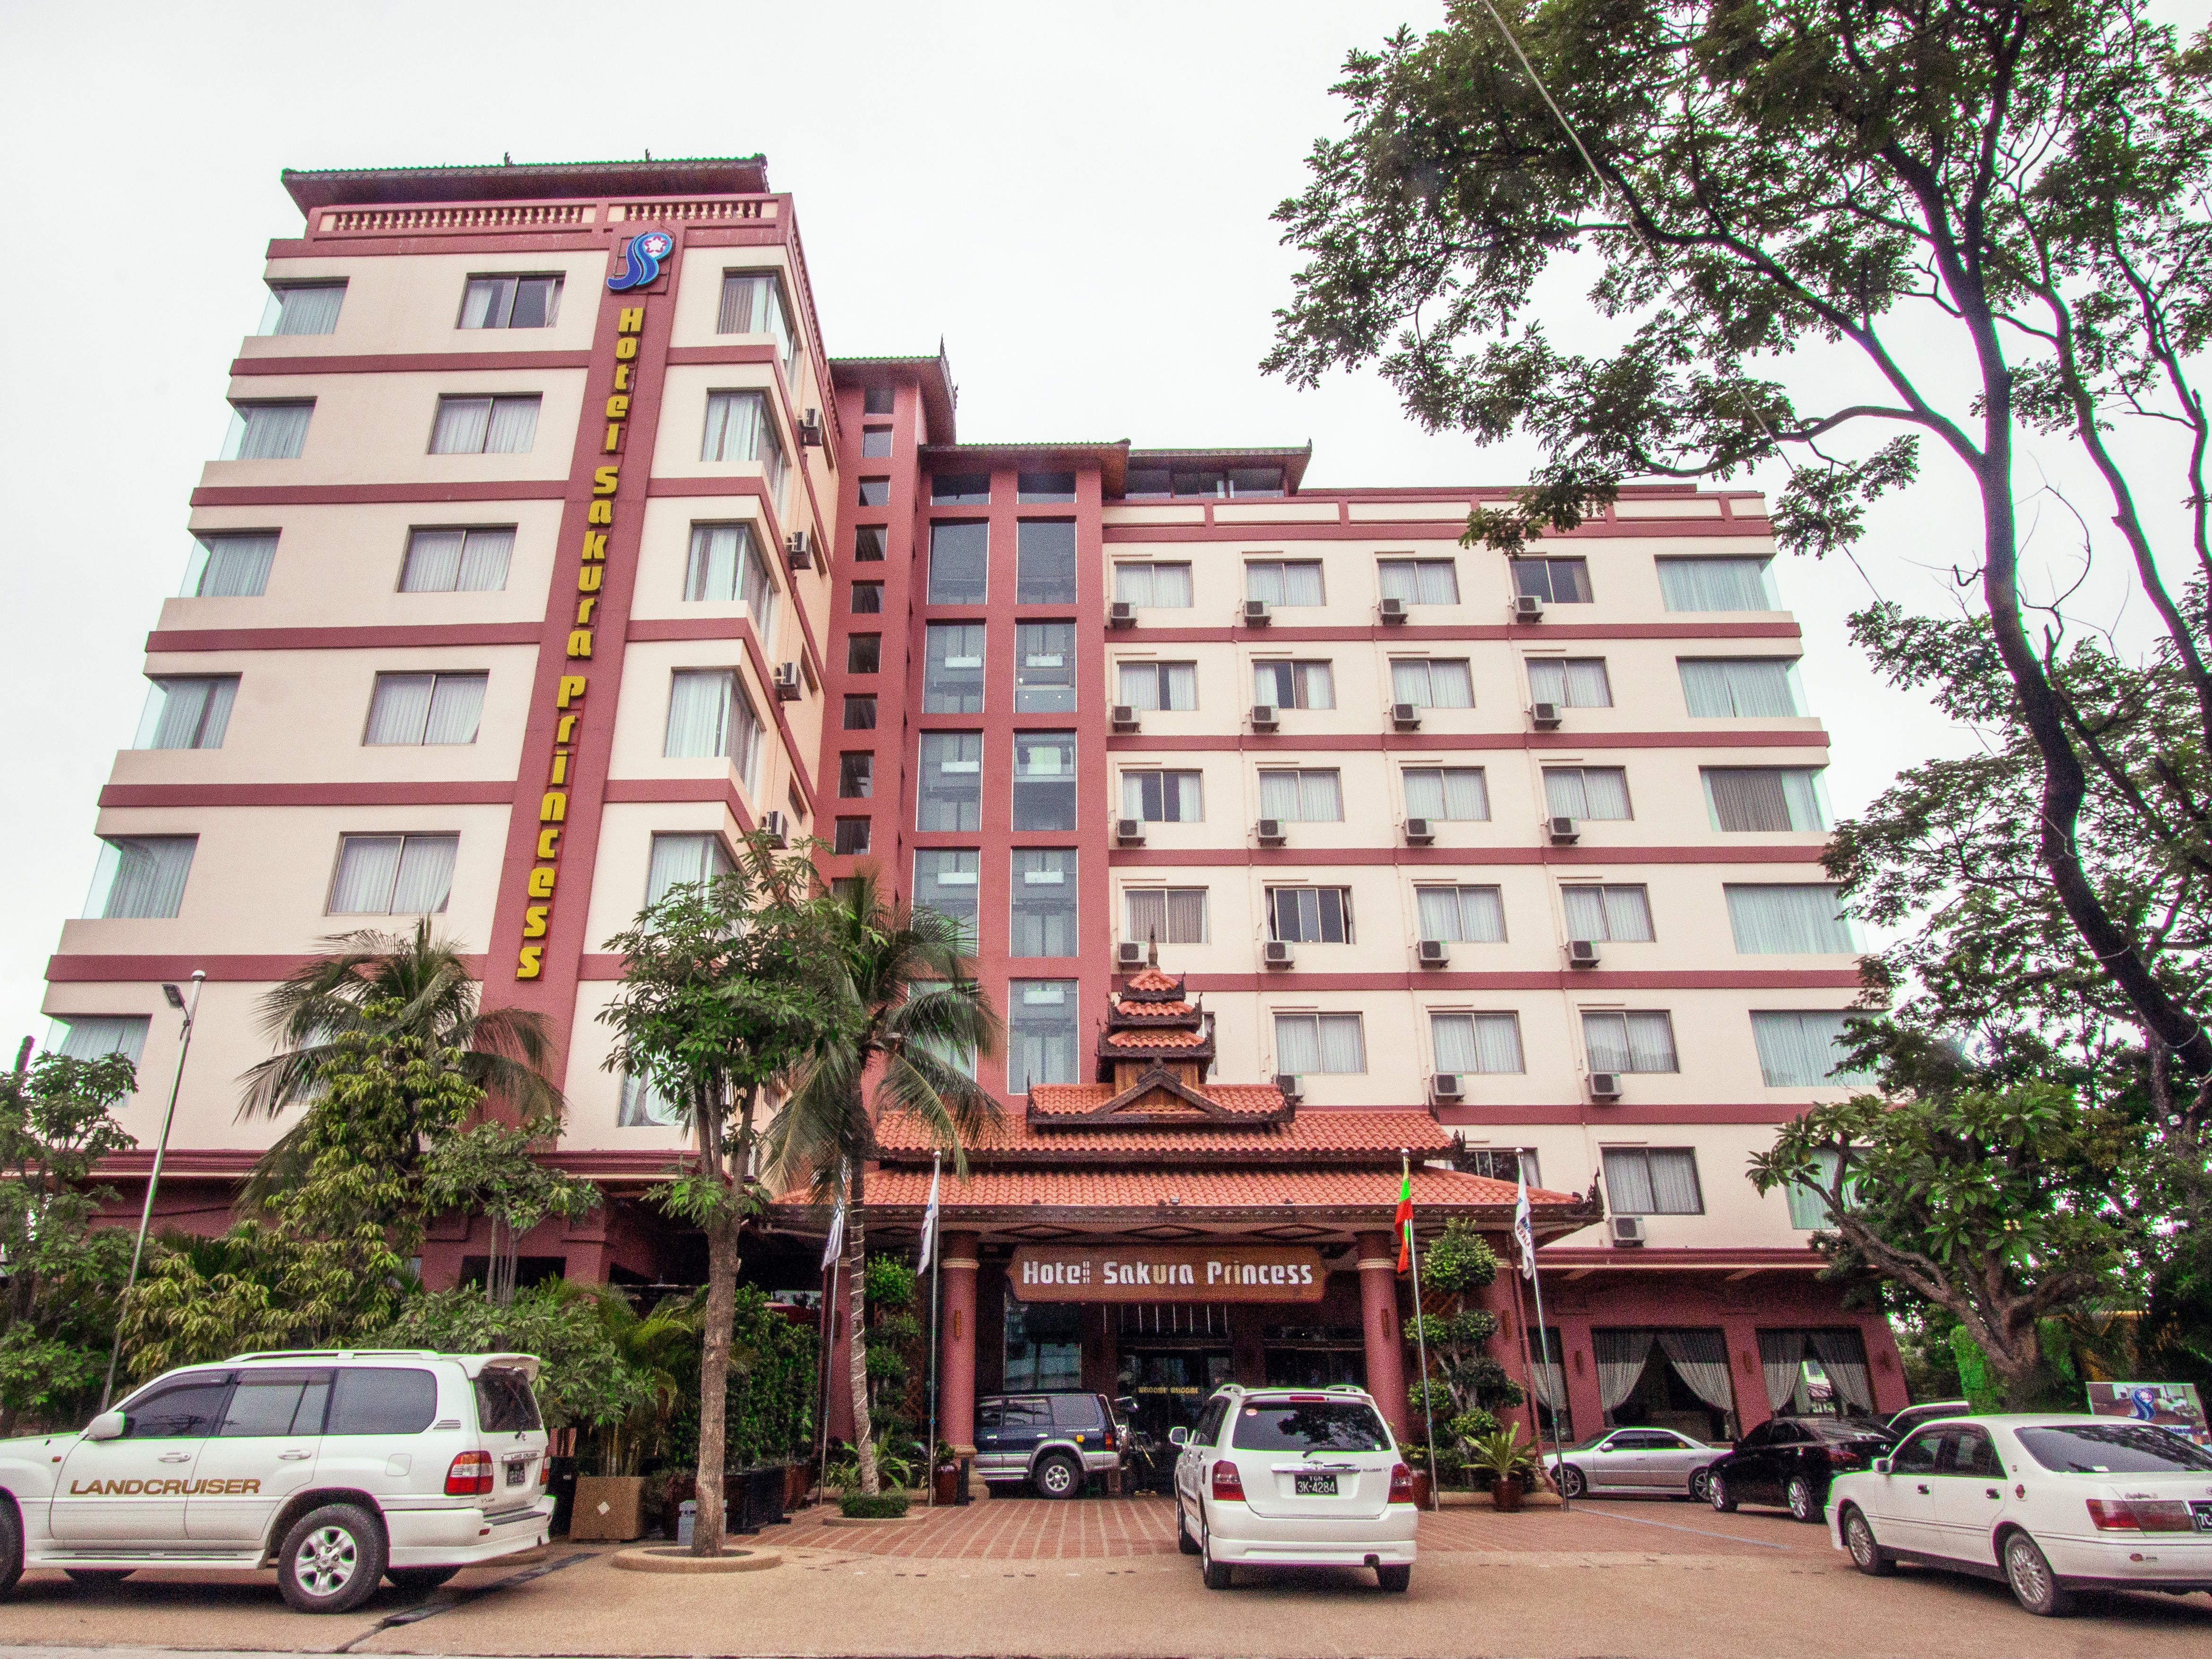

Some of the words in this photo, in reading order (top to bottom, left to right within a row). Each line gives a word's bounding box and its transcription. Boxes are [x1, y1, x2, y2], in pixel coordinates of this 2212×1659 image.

[604, 306, 644, 454] Hotel
[566, 465, 619, 659] Sakura
[515, 675, 588, 981] Princess
[1022, 1260, 1090, 1285] Hotel
[1104, 1261, 1194, 1285] Sakura
[1207, 1260, 1314, 1285] Princess
[69, 1478, 261, 1495] LANDCRUISER
[1297, 1481, 1335, 1493] 3K-4284
